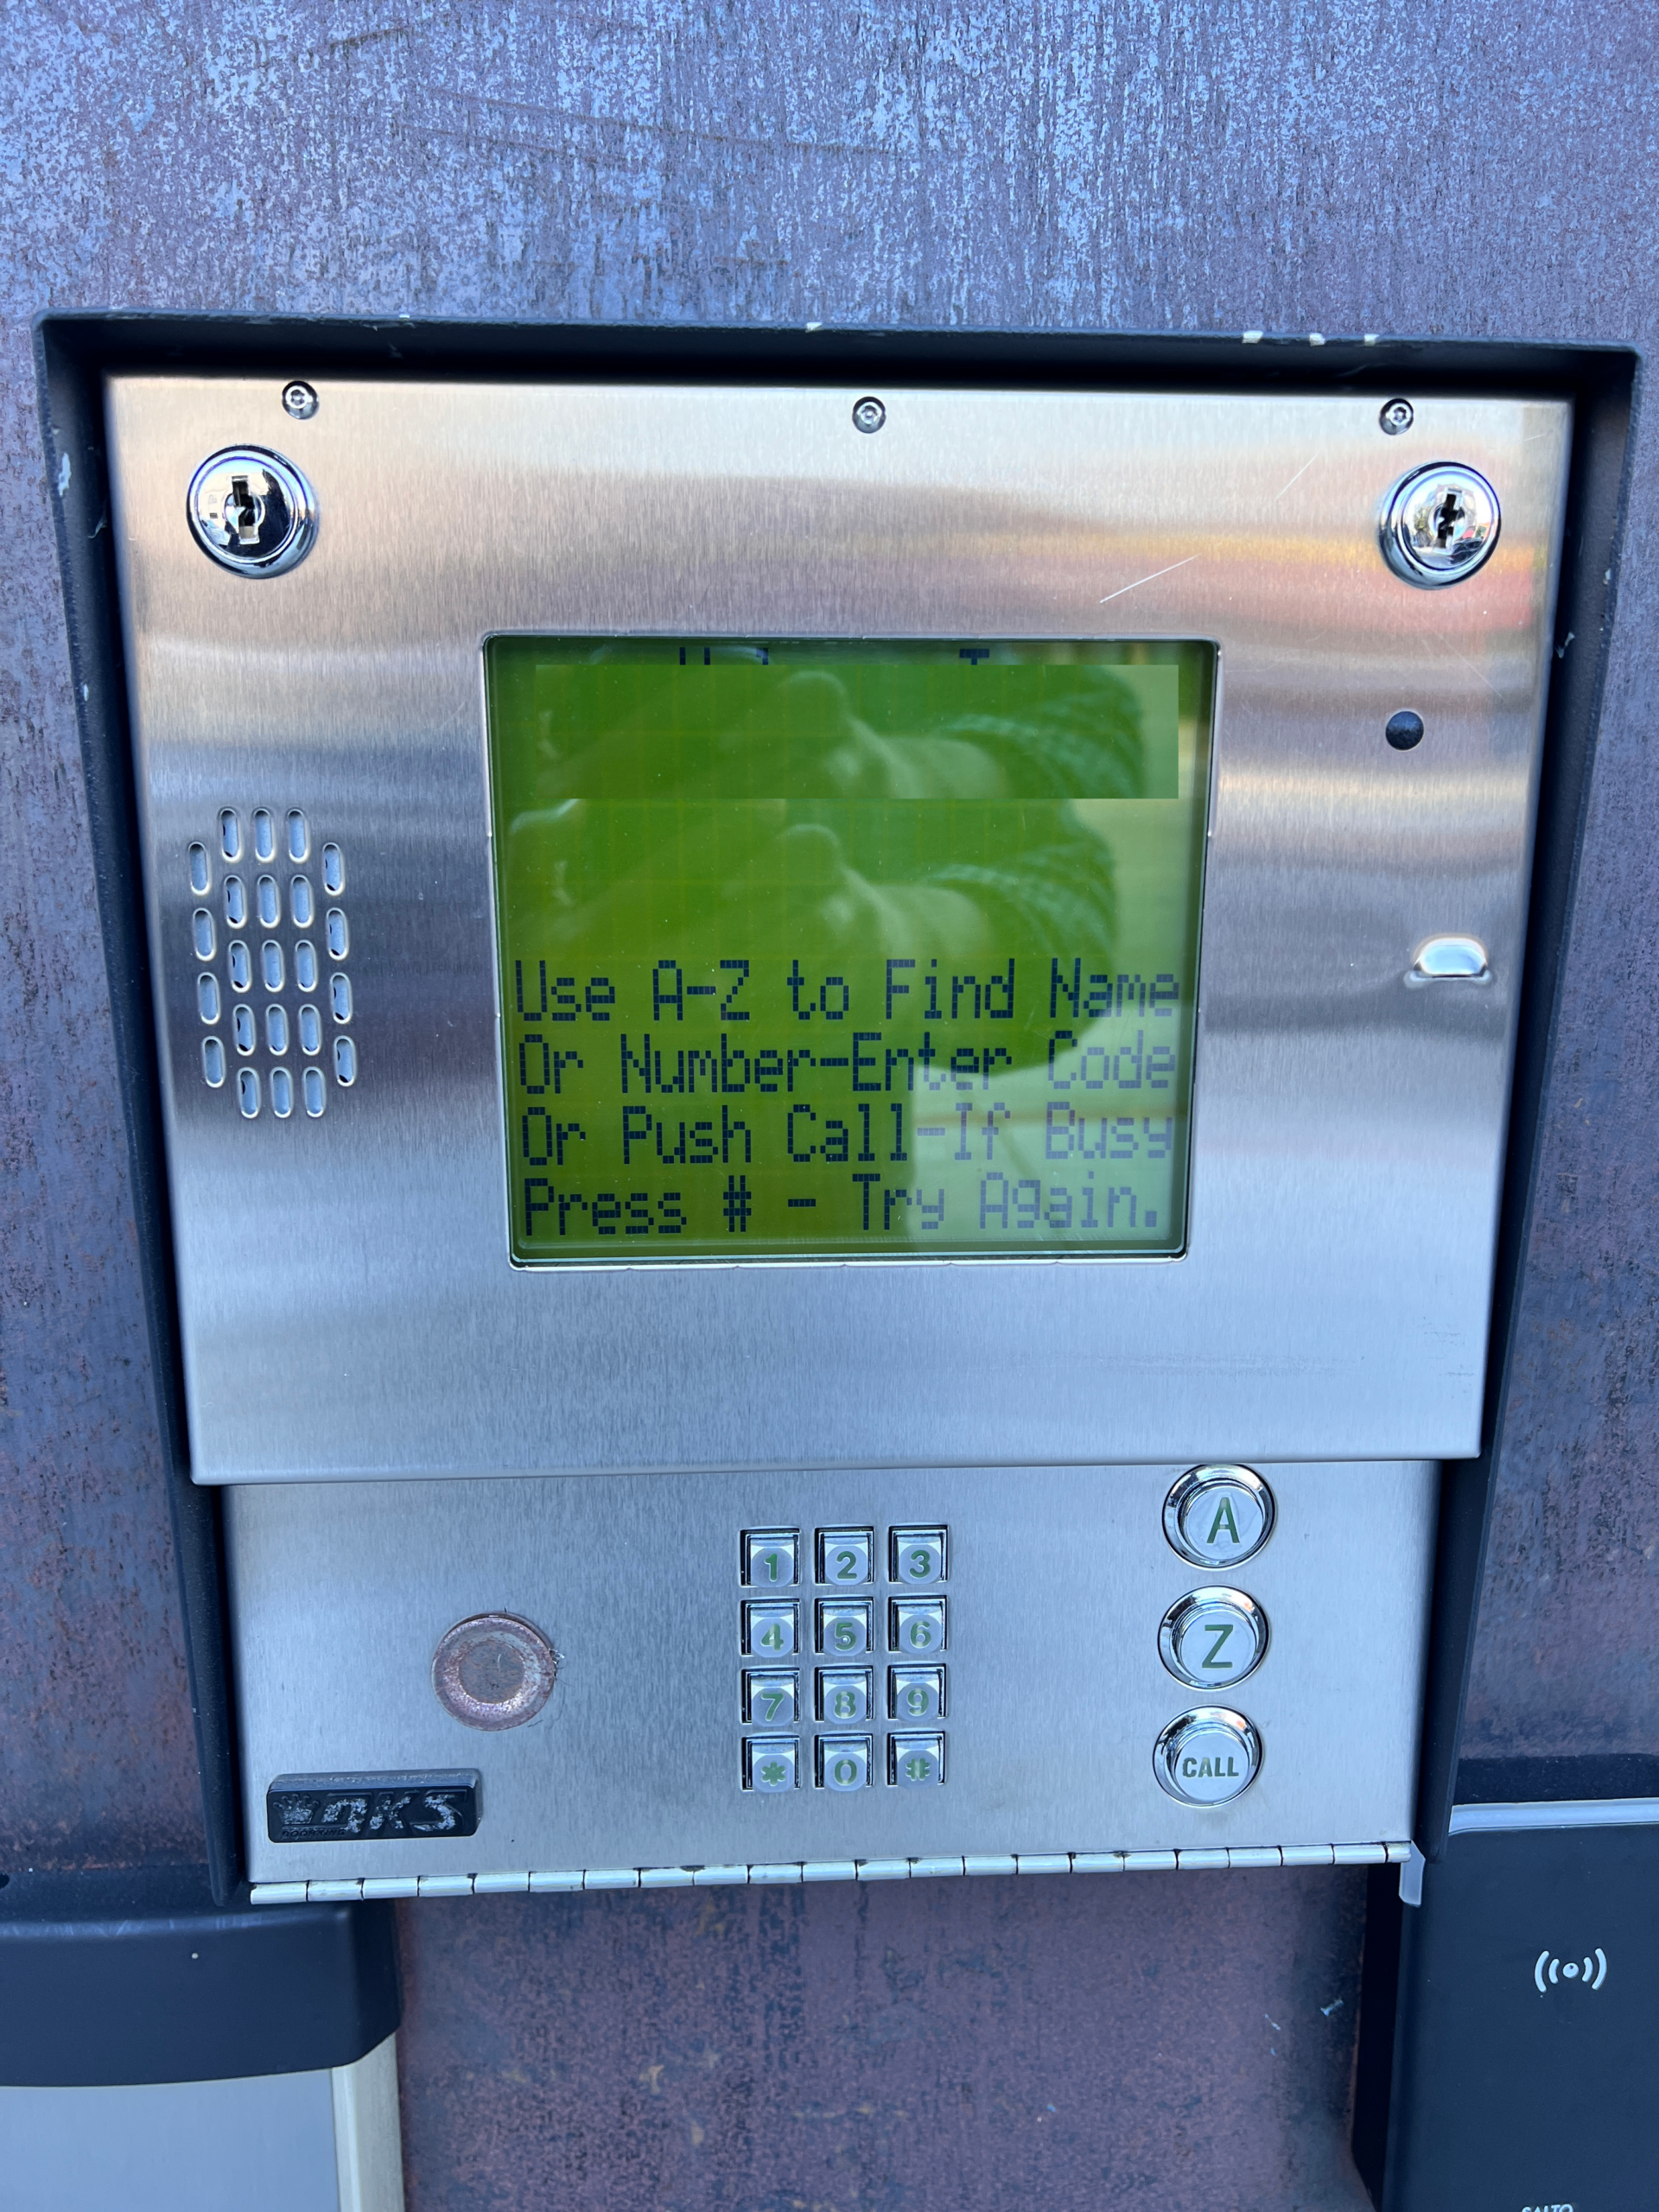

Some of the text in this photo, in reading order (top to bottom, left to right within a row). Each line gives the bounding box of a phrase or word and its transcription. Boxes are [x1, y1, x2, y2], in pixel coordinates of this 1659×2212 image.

[515, 957, 1179, 1021] Use A-Z to Find Name
[518, 1030, 1175, 1094] Or Number-Enter Code
[522, 1102, 1173, 1165] Or Push Call-If Busy
[524, 1178, 687, 1236] Press
[723, 1175, 752, 1232] #
[852, 1173, 944, 1230] Try
[980, 1172, 1157, 1229] Again.
[1206, 1497, 1240, 1544] A
[765, 1549, 931, 1582] 1 2 3
[760, 1621, 931, 1651] 4 5 6
[1201, 1624, 1234, 1669] Z
[761, 1688, 929, 1721] 7 8 9
[834, 1759, 858, 1785] 0
[1182, 1757, 1239, 1778] CALL
